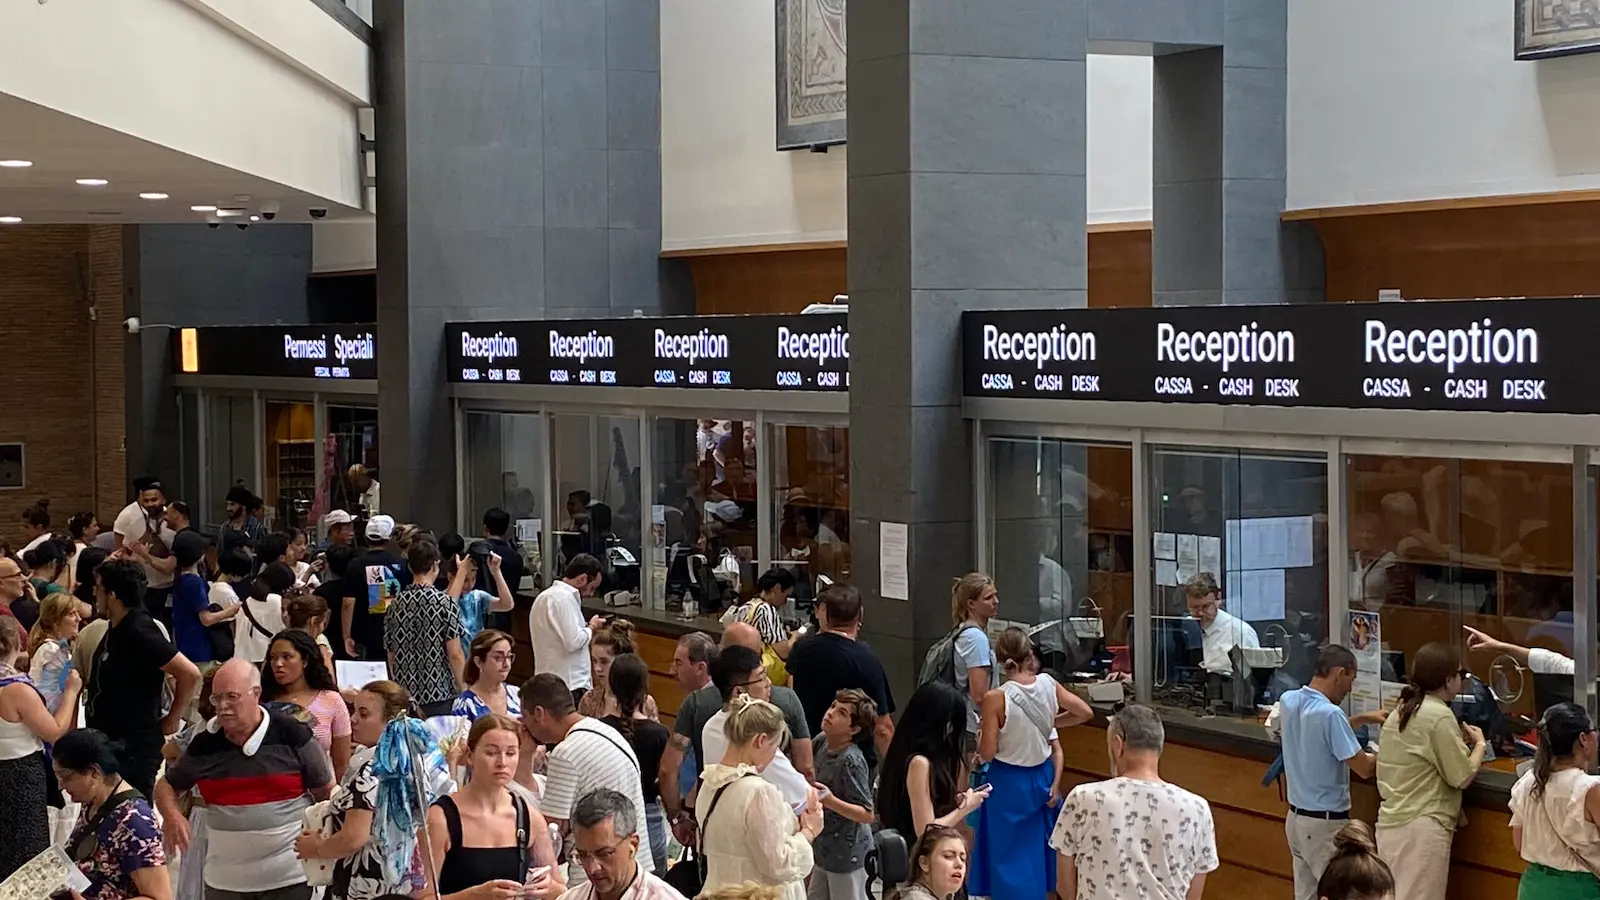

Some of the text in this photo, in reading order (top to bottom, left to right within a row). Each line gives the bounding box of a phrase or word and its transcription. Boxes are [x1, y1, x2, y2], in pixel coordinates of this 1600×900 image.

[284, 332, 374, 365] Permessi Speciali
[461, 330, 518, 364] Reception
[549, 329, 614, 364] Reception
[654, 327, 729, 366] Reception
[777, 324, 850, 366] Receptio
[983, 323, 1096, 369] Reception
[1157, 321, 1295, 372] Reception
[1365, 317, 1538, 373] Reception
[462, 368, 480, 380] CASSA
[488, 368, 503, 381] CASH
[506, 369, 521, 381] DESK
[549, 369, 570, 382] CASSA
[579, 370, 596, 383] CASH
[599, 370, 617, 383] DESK
[653, 369, 677, 384] CASSA
[688, 370, 708, 384] CASH
[712, 370, 732, 385] DESK
[776, 370, 803, 386] CASSA
[816, 371, 840, 387] CASH
[981, 373, 1014, 390] CASSA
[1034, 374, 1063, 391] CASH
[1071, 375, 1100, 392] DESK
[1154, 376, 1194, 395] CASSA
[1218, 377, 1254, 396] CASH
[1265, 378, 1300, 397] DESK
[1362, 377, 1412, 398] CASSA
[1443, 378, 1488, 399] CASH
[1502, 379, 1546, 400] DESK
